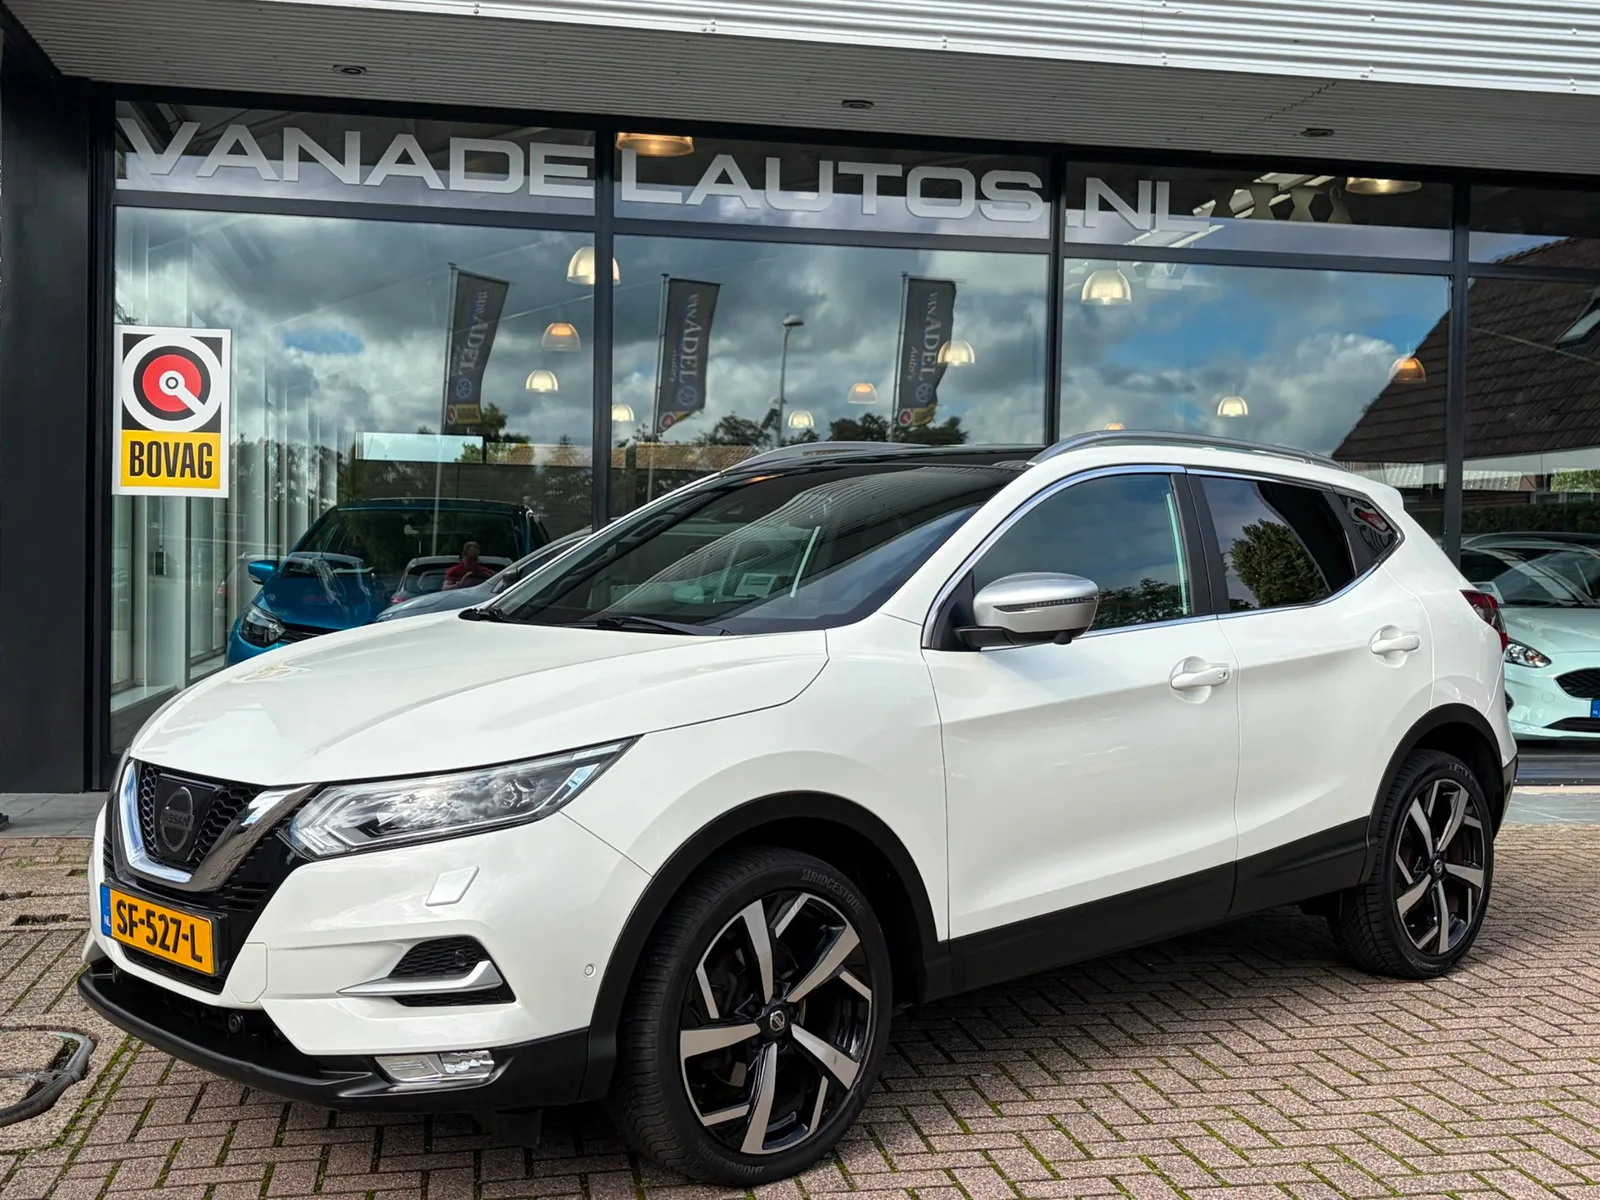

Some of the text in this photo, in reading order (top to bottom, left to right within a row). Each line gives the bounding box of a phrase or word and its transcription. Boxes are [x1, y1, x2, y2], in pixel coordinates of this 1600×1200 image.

[129, 441, 213, 479] BOVAG
[801, 868, 863, 914] BRIDGESTONE
[116, 899, 203, 963] SF-527-L
